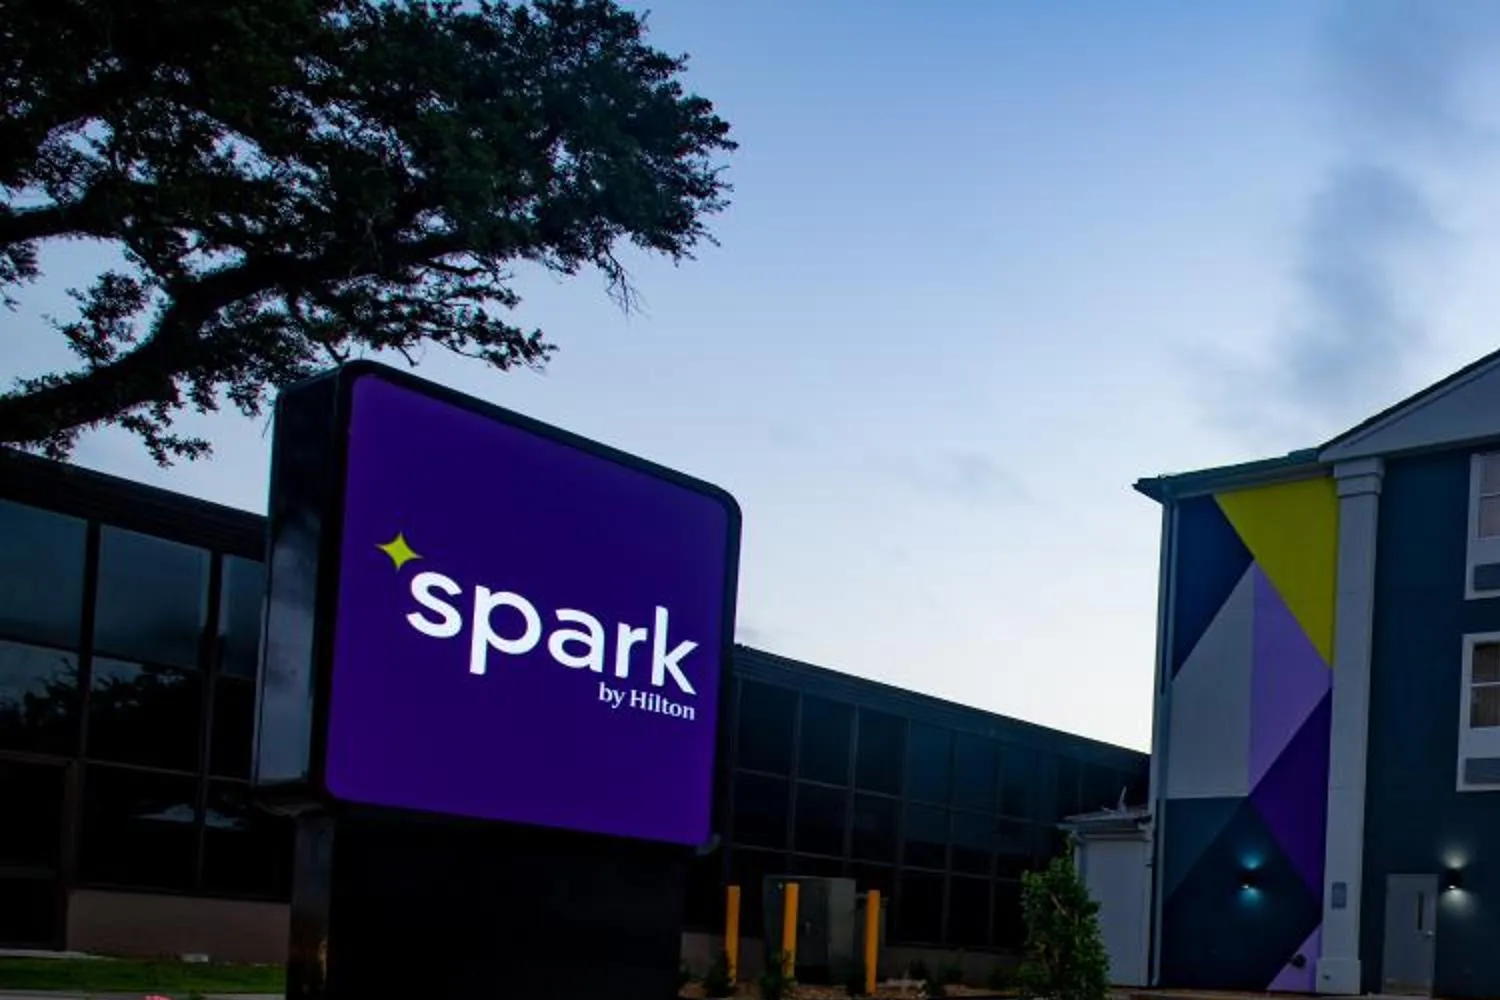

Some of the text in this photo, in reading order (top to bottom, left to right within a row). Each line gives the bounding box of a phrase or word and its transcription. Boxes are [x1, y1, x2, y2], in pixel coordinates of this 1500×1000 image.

[406, 571, 698, 695] spark
[599, 682, 695, 720] by Hilton
